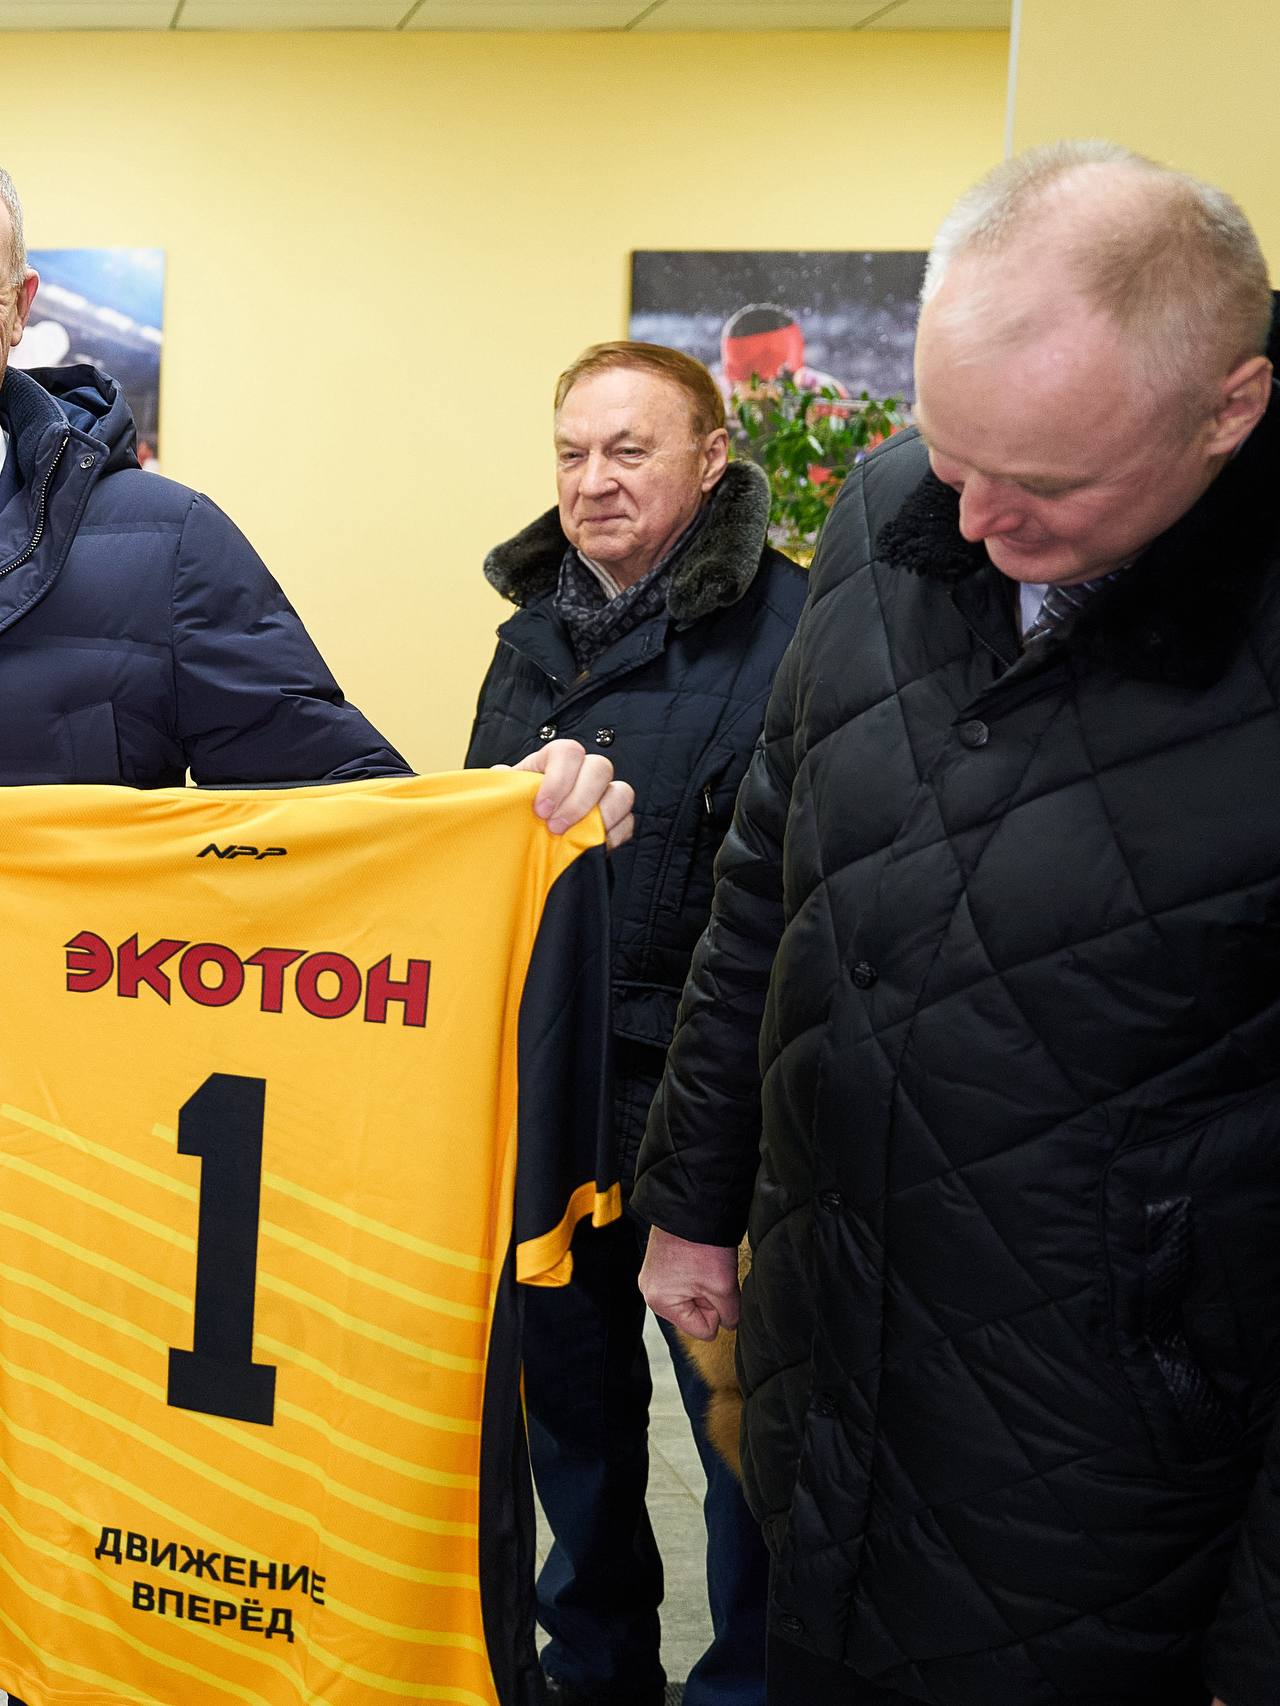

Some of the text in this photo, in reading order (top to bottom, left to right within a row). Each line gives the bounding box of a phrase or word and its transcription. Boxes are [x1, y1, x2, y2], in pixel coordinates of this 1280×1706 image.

[63, 930, 432, 1029] ЭКОТОН
[166, 1072, 278, 1427] 1
[94, 1526, 327, 1606] ДВИЖЕНИЕ
[131, 1580, 295, 1644] ВПЕРЁД
